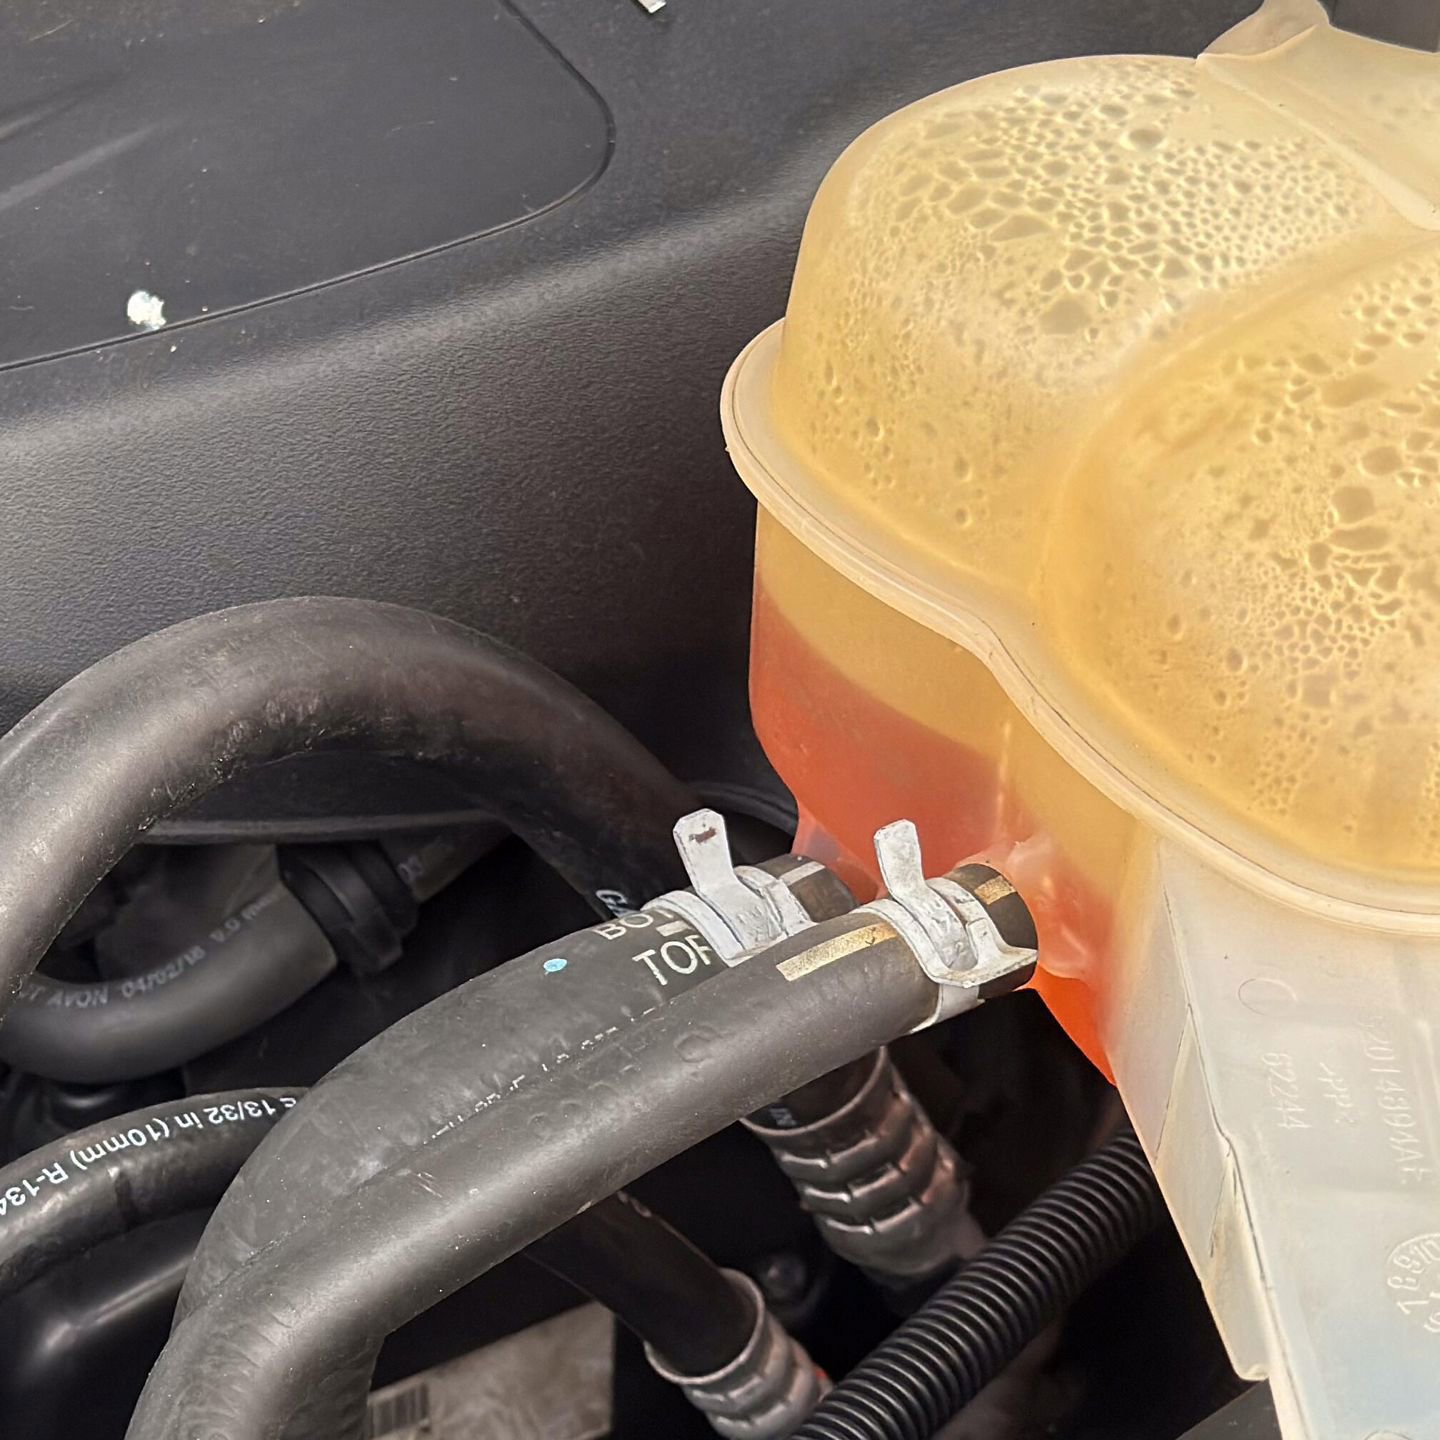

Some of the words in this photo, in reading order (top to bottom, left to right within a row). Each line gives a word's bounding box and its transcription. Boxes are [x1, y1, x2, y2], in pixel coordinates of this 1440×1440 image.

[179, 1111, 204, 1130] in
[208, 1097, 276, 1125] 13/32
[69, 1117, 171, 1172] (10mm)
